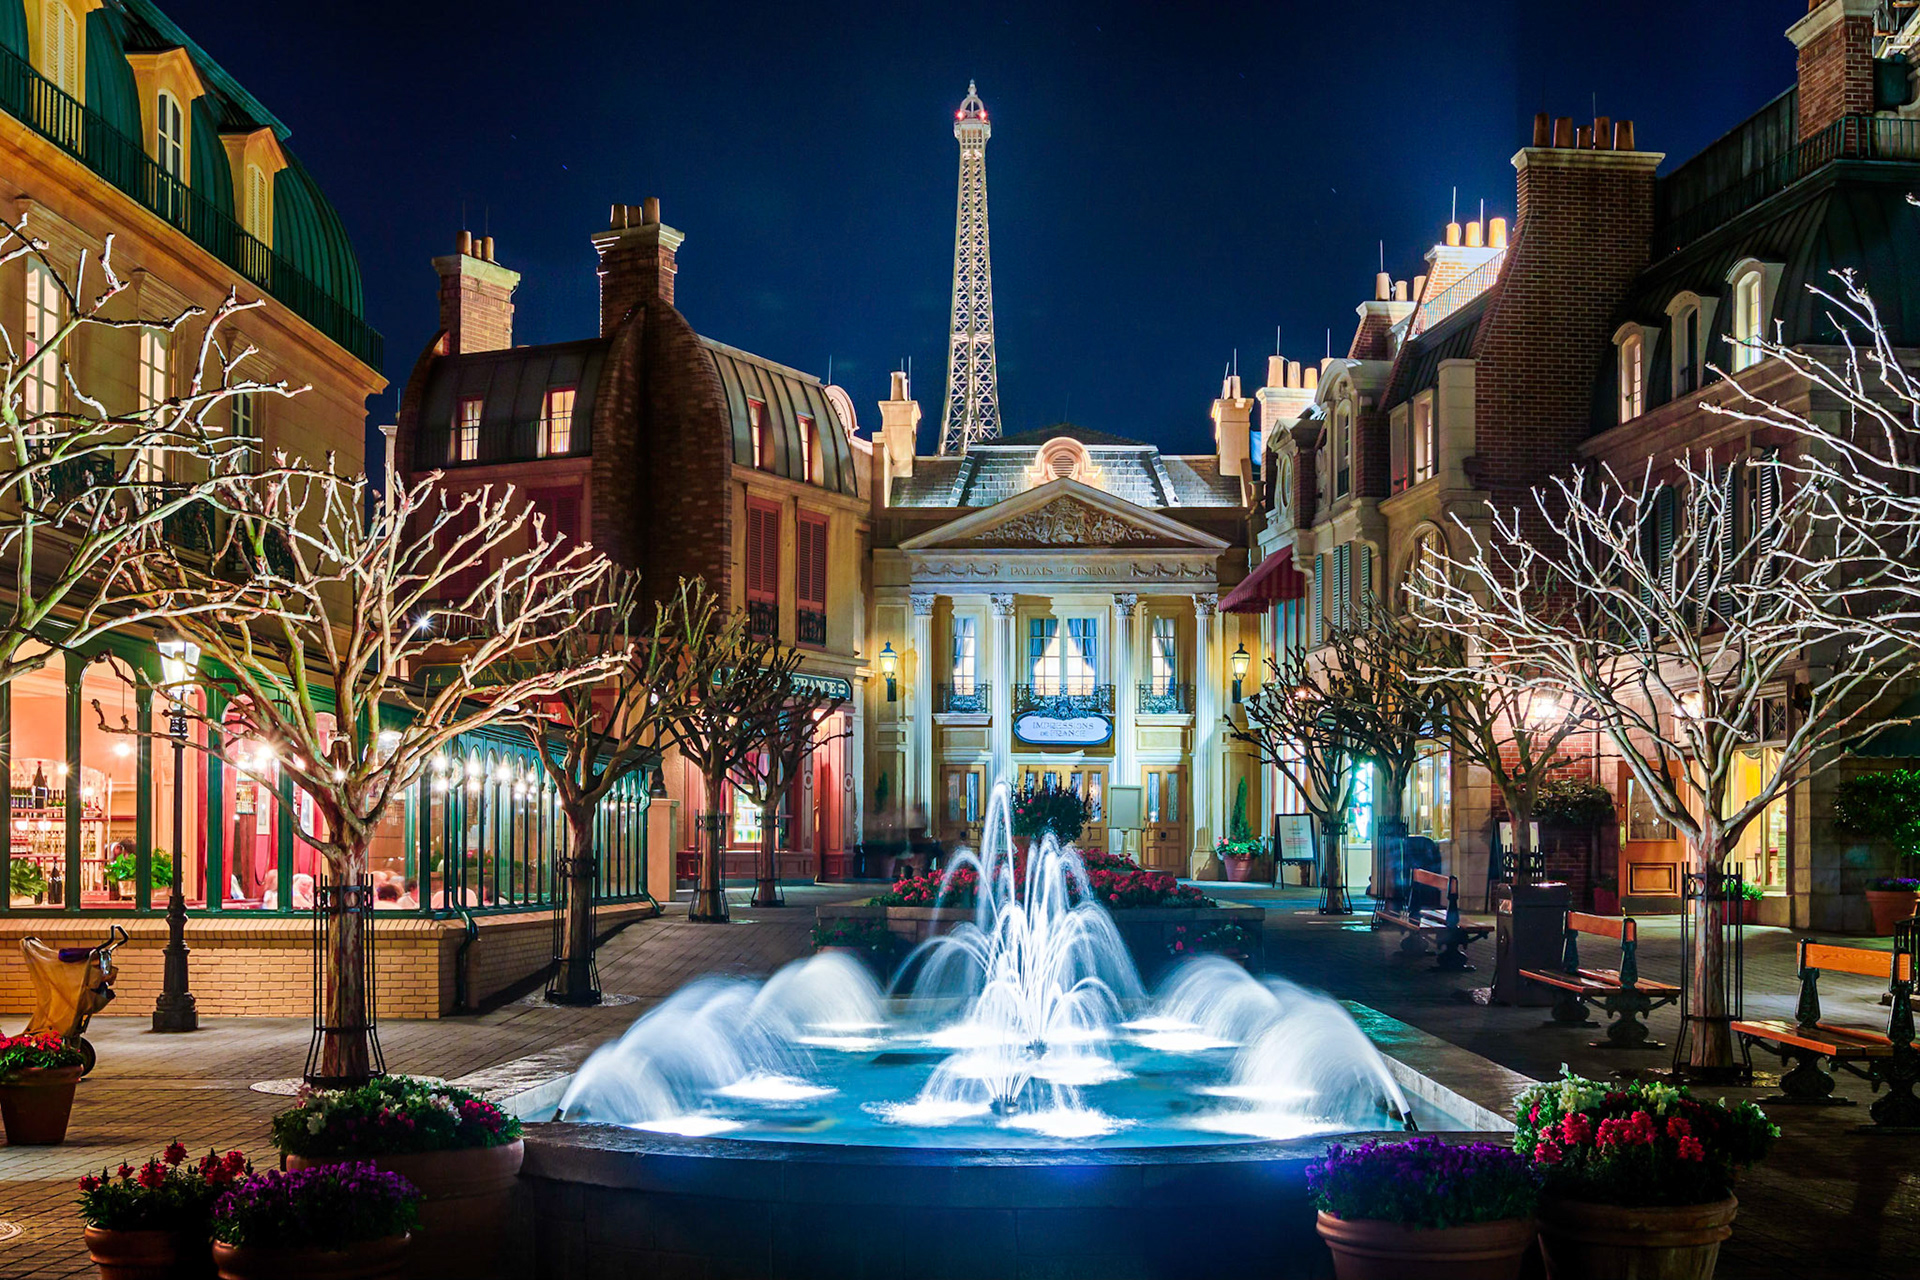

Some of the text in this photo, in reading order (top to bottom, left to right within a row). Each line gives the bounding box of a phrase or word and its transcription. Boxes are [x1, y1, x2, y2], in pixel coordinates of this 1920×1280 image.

[1010, 566, 1054, 576] PALAIS
[1070, 566, 1117, 576] CINEMA
[793, 677, 837, 693] FRANCE
